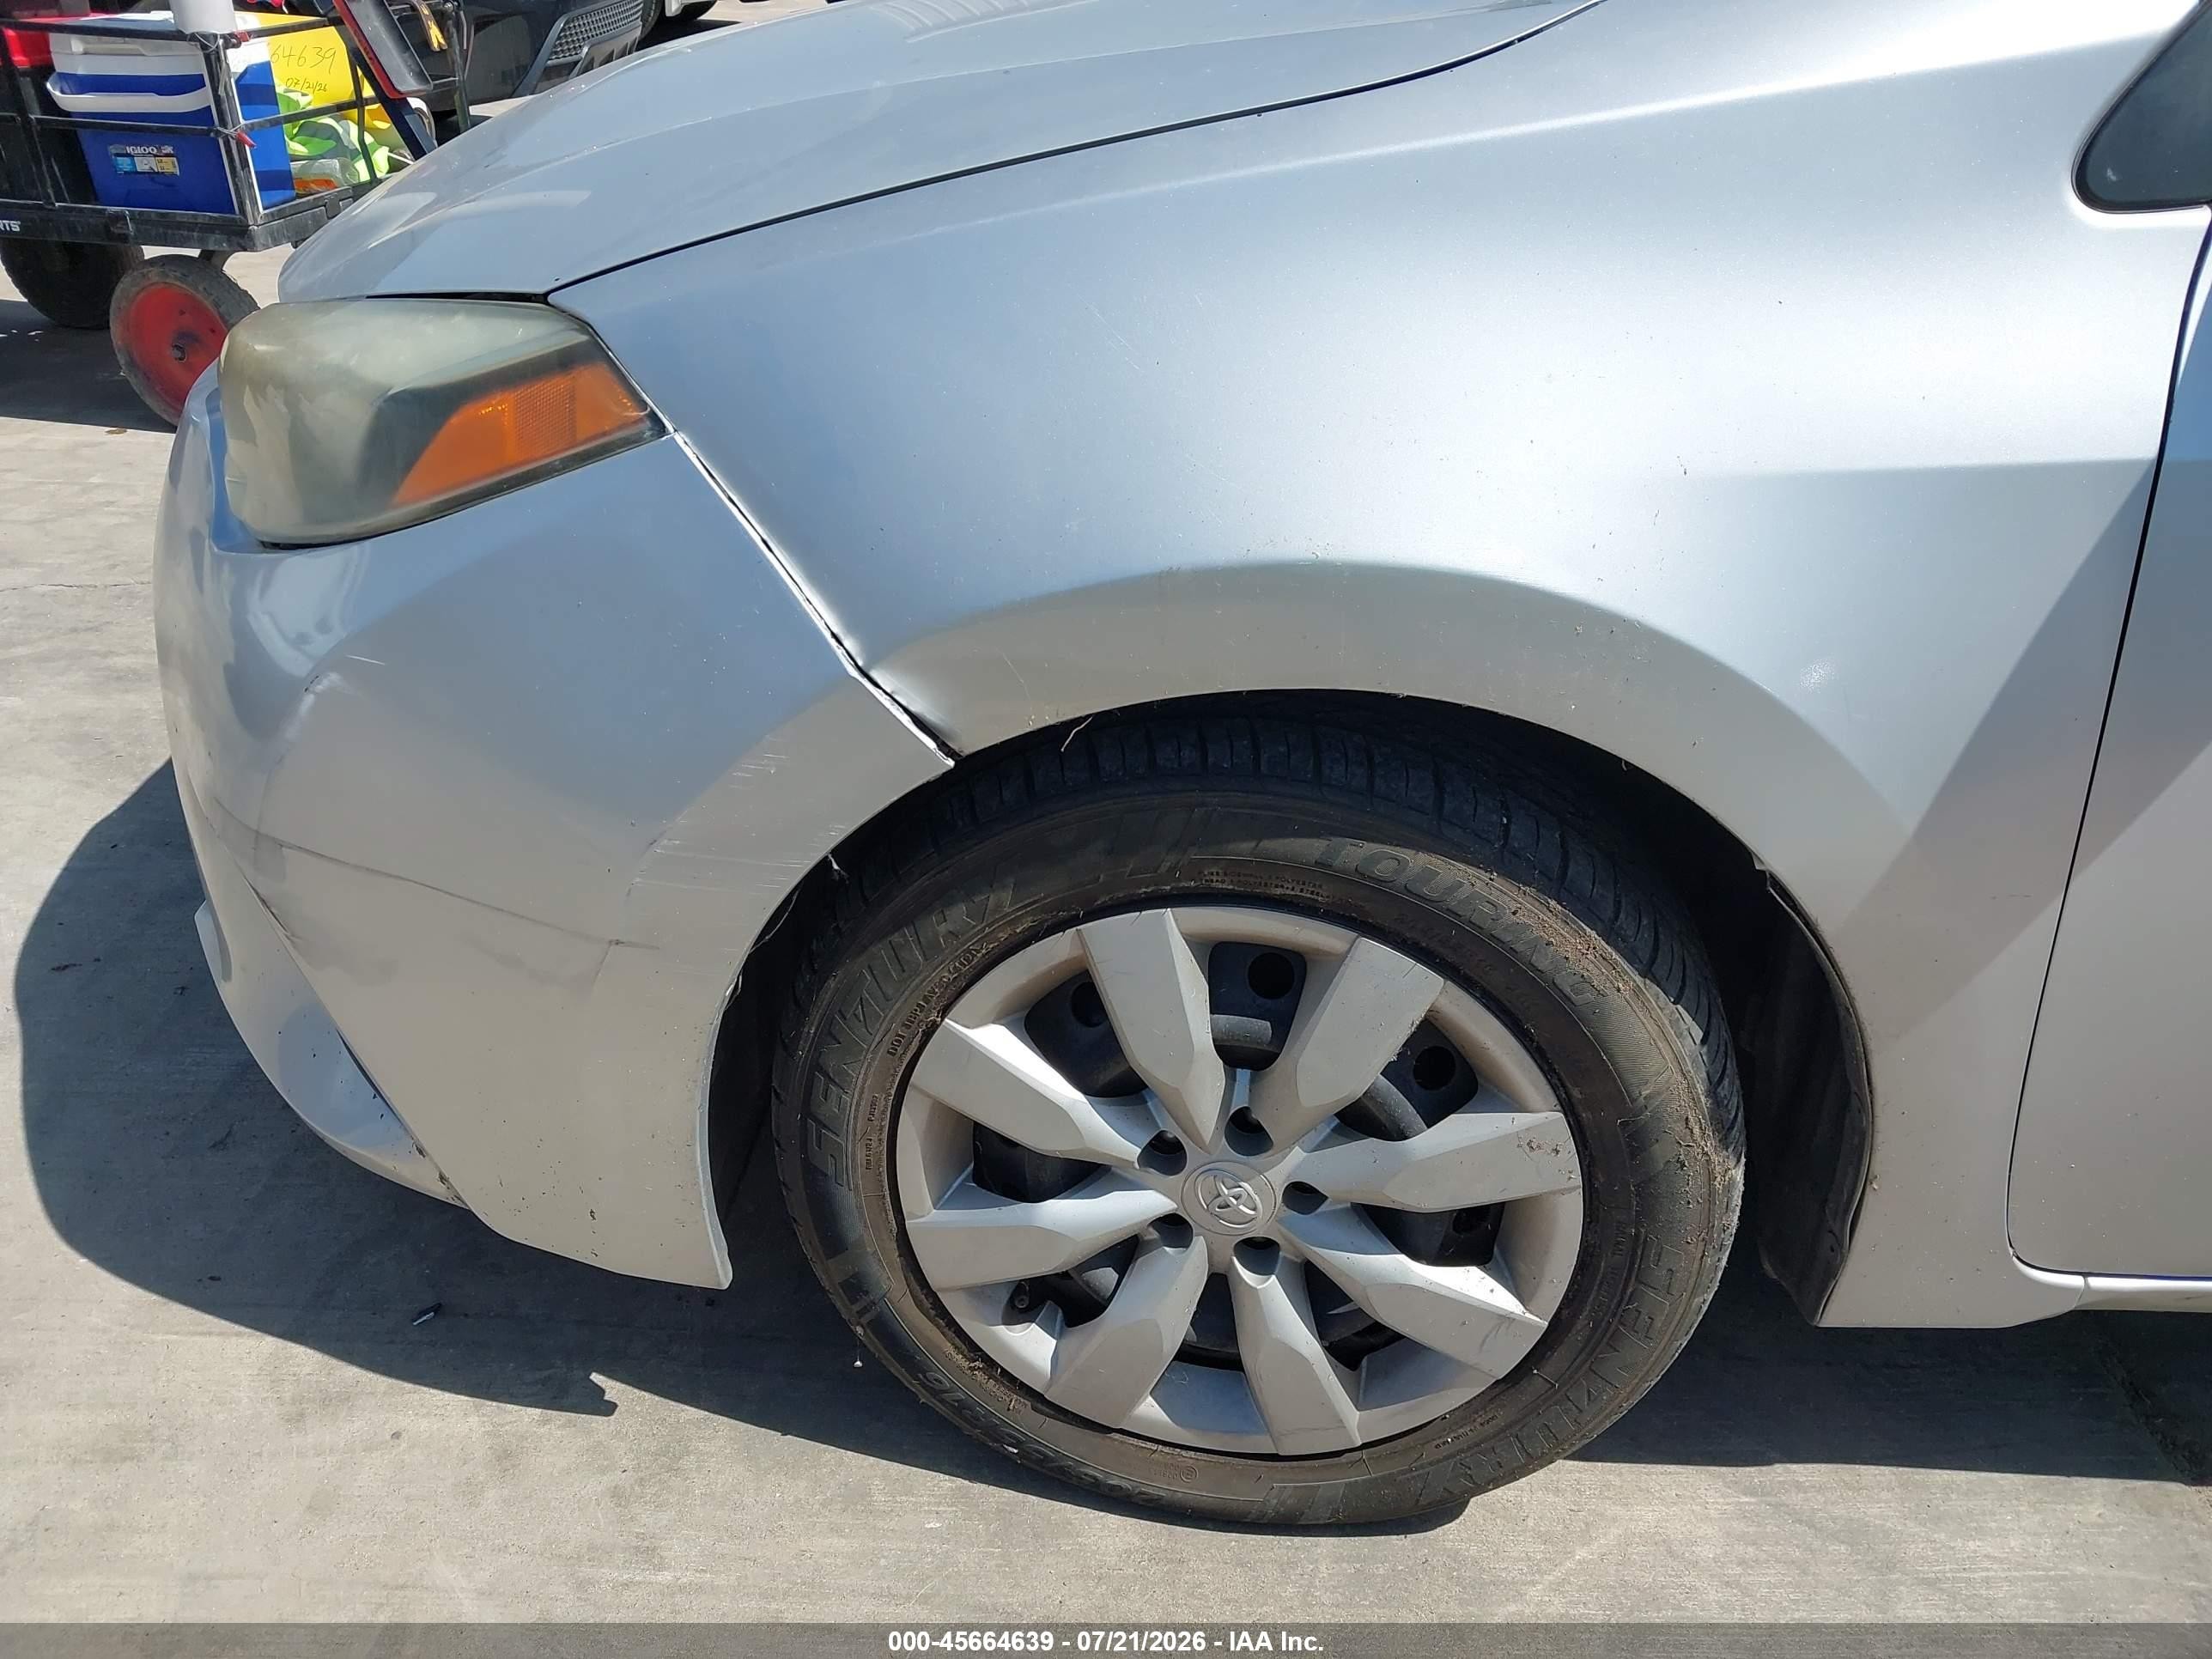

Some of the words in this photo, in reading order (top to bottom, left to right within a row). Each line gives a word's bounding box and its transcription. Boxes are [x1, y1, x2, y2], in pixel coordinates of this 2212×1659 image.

[270, 45, 337, 75] 64639
[285, 77, 327, 94] 07/21/26
[125, 145, 157, 154] IGLOO
[1315, 836, 1609, 1006] TOURING
[801, 867, 1022, 1188] SENTURY
